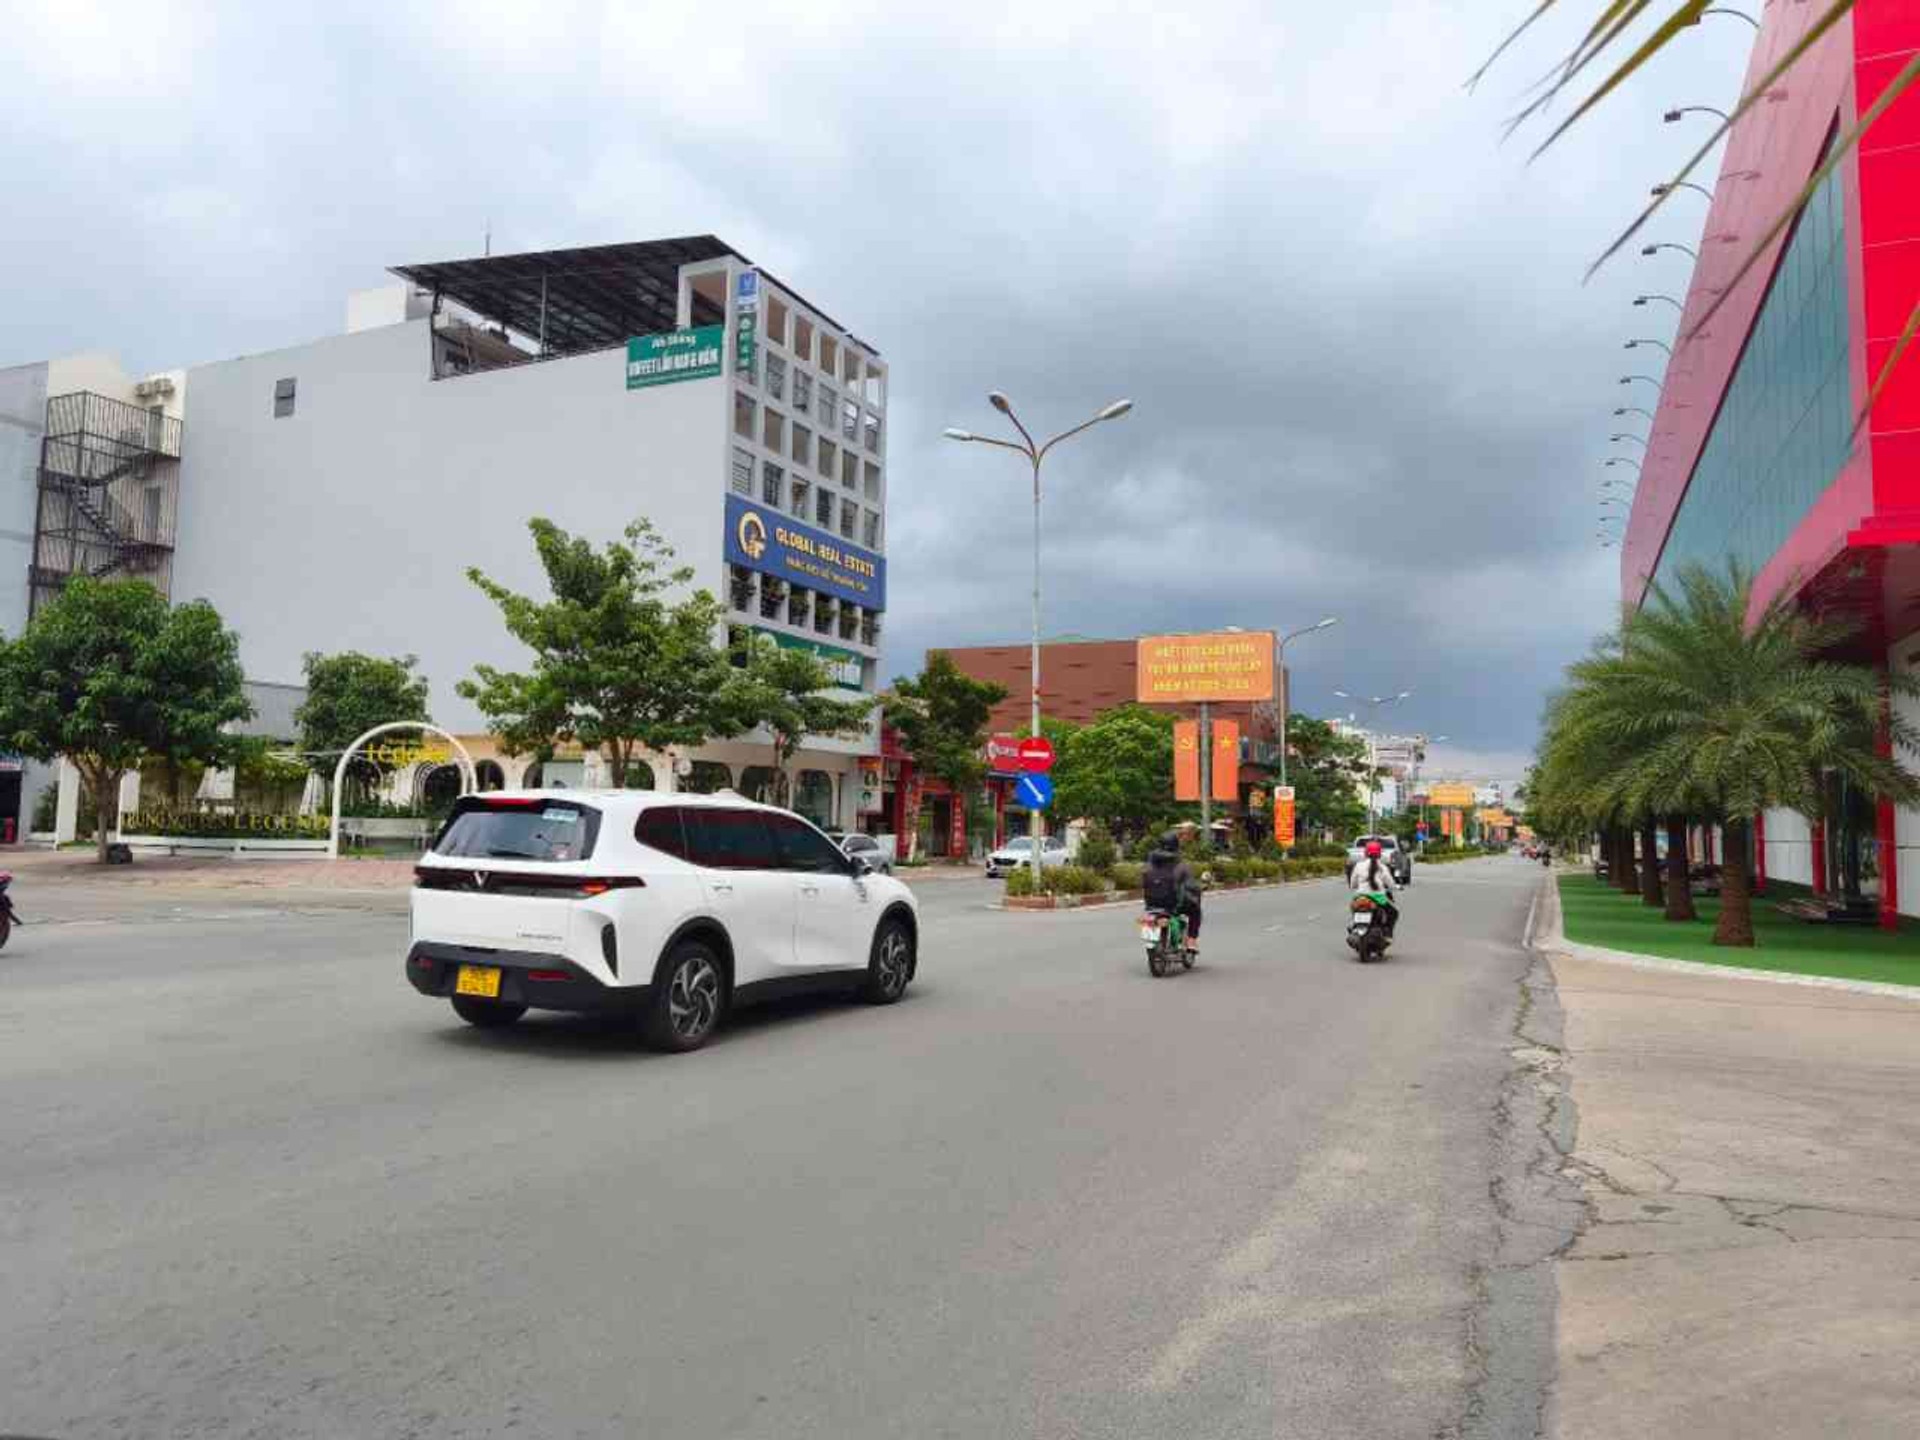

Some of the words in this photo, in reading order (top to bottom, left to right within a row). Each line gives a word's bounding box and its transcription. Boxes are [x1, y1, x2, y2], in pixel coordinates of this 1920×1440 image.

[775, 527, 817, 555] GLOBAL
[817, 543, 842, 566] REAL
[844, 554, 876, 578] ESTATE
[233, 813, 331, 831] LEGEND
